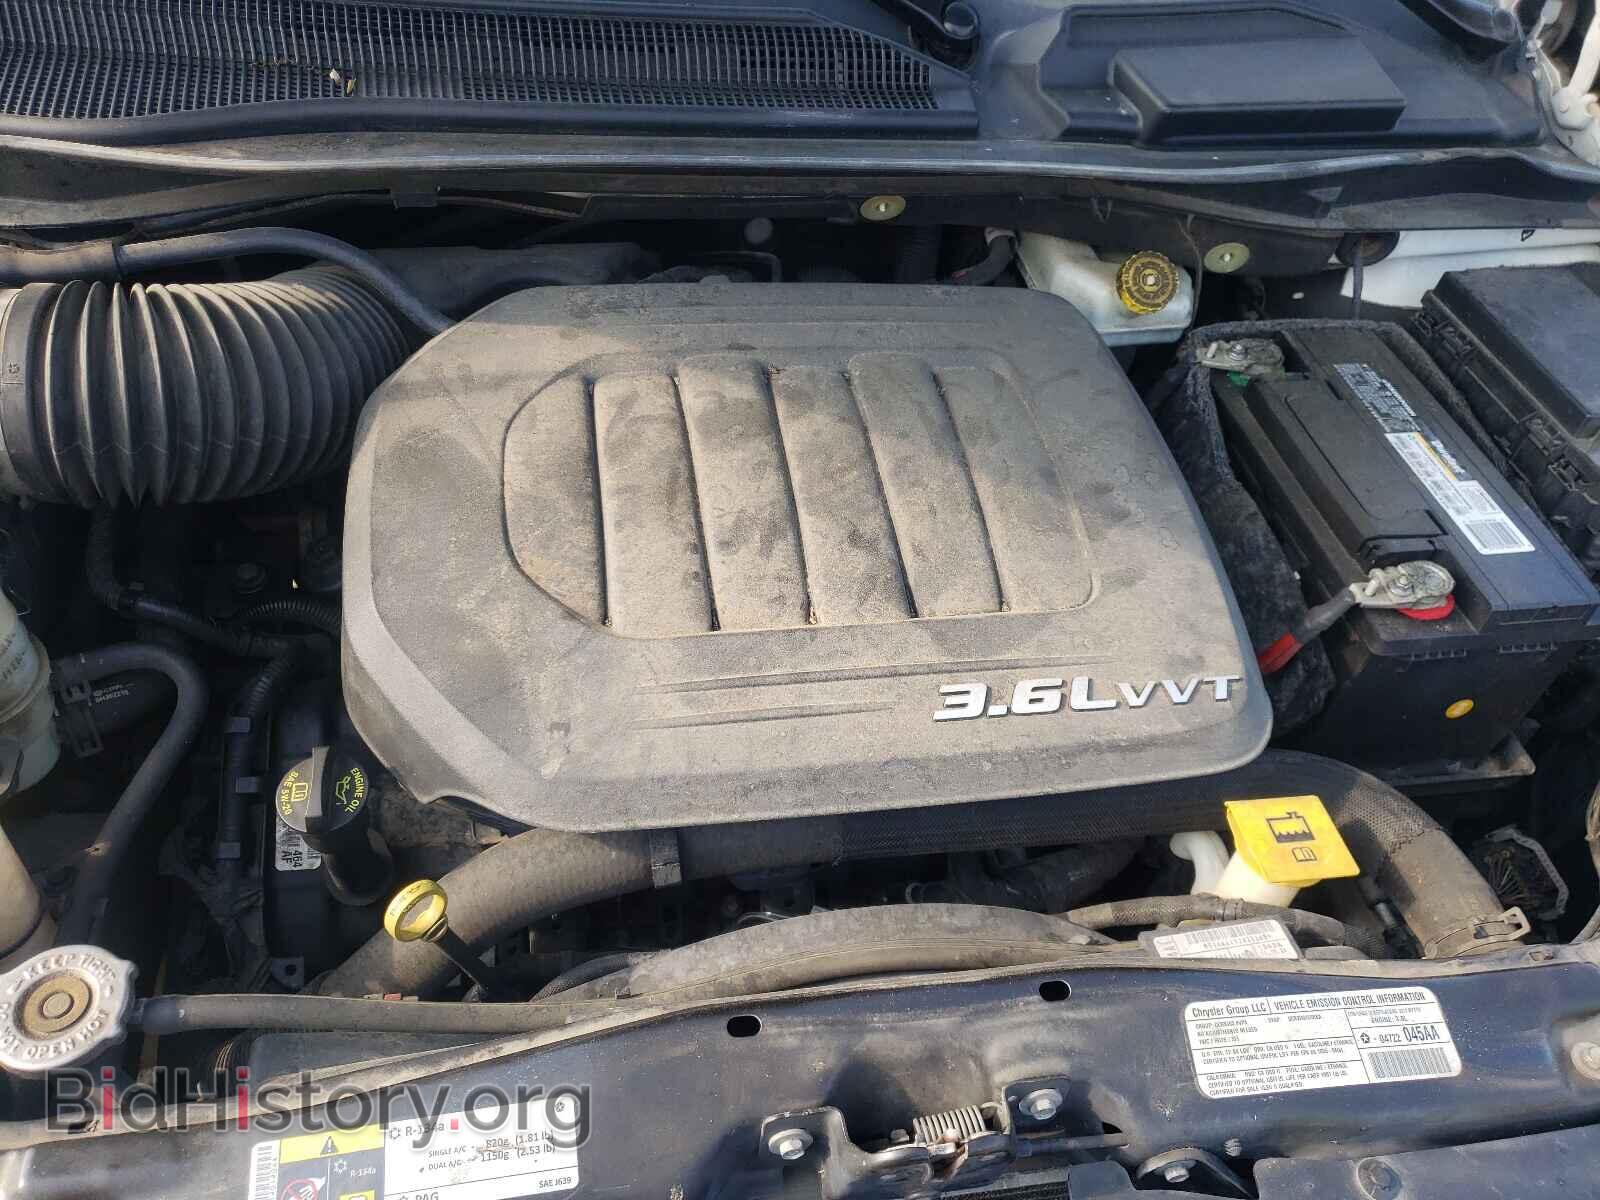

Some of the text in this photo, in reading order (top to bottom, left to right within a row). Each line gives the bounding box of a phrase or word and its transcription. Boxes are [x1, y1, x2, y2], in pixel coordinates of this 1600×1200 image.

[933, 675, 1243, 721] 3.6L VVT
[345, 768, 365, 813] ENGINE OIL
[281, 850, 293, 864] AF
[292, 850, 302, 868] 464
[1192, 1002, 1267, 1018] Chrysler Group LLC
[1273, 992, 1426, 1011] VEHICLE EMISSION CONTROL INFORMATION
[1402, 1025, 1440, 1043] 045AA
[22, 1037, 76, 1060] OPEN
[405, 1121, 445, 1137] R-134a
[428, 1149, 453, 1158] SINGLE
[515, 1133, 538, 1146] (1.81
[541, 1130, 554, 1141] lb)
[428, 1163, 447, 1171] DUAL
[481, 1151, 510, 1163] 1150g
[517, 1145, 540, 1158] (2.53
[543, 1142, 556, 1153] lb)
[539, 1177, 572, 1188] SAE J639
[415, 1192, 439, 1200] PAG
